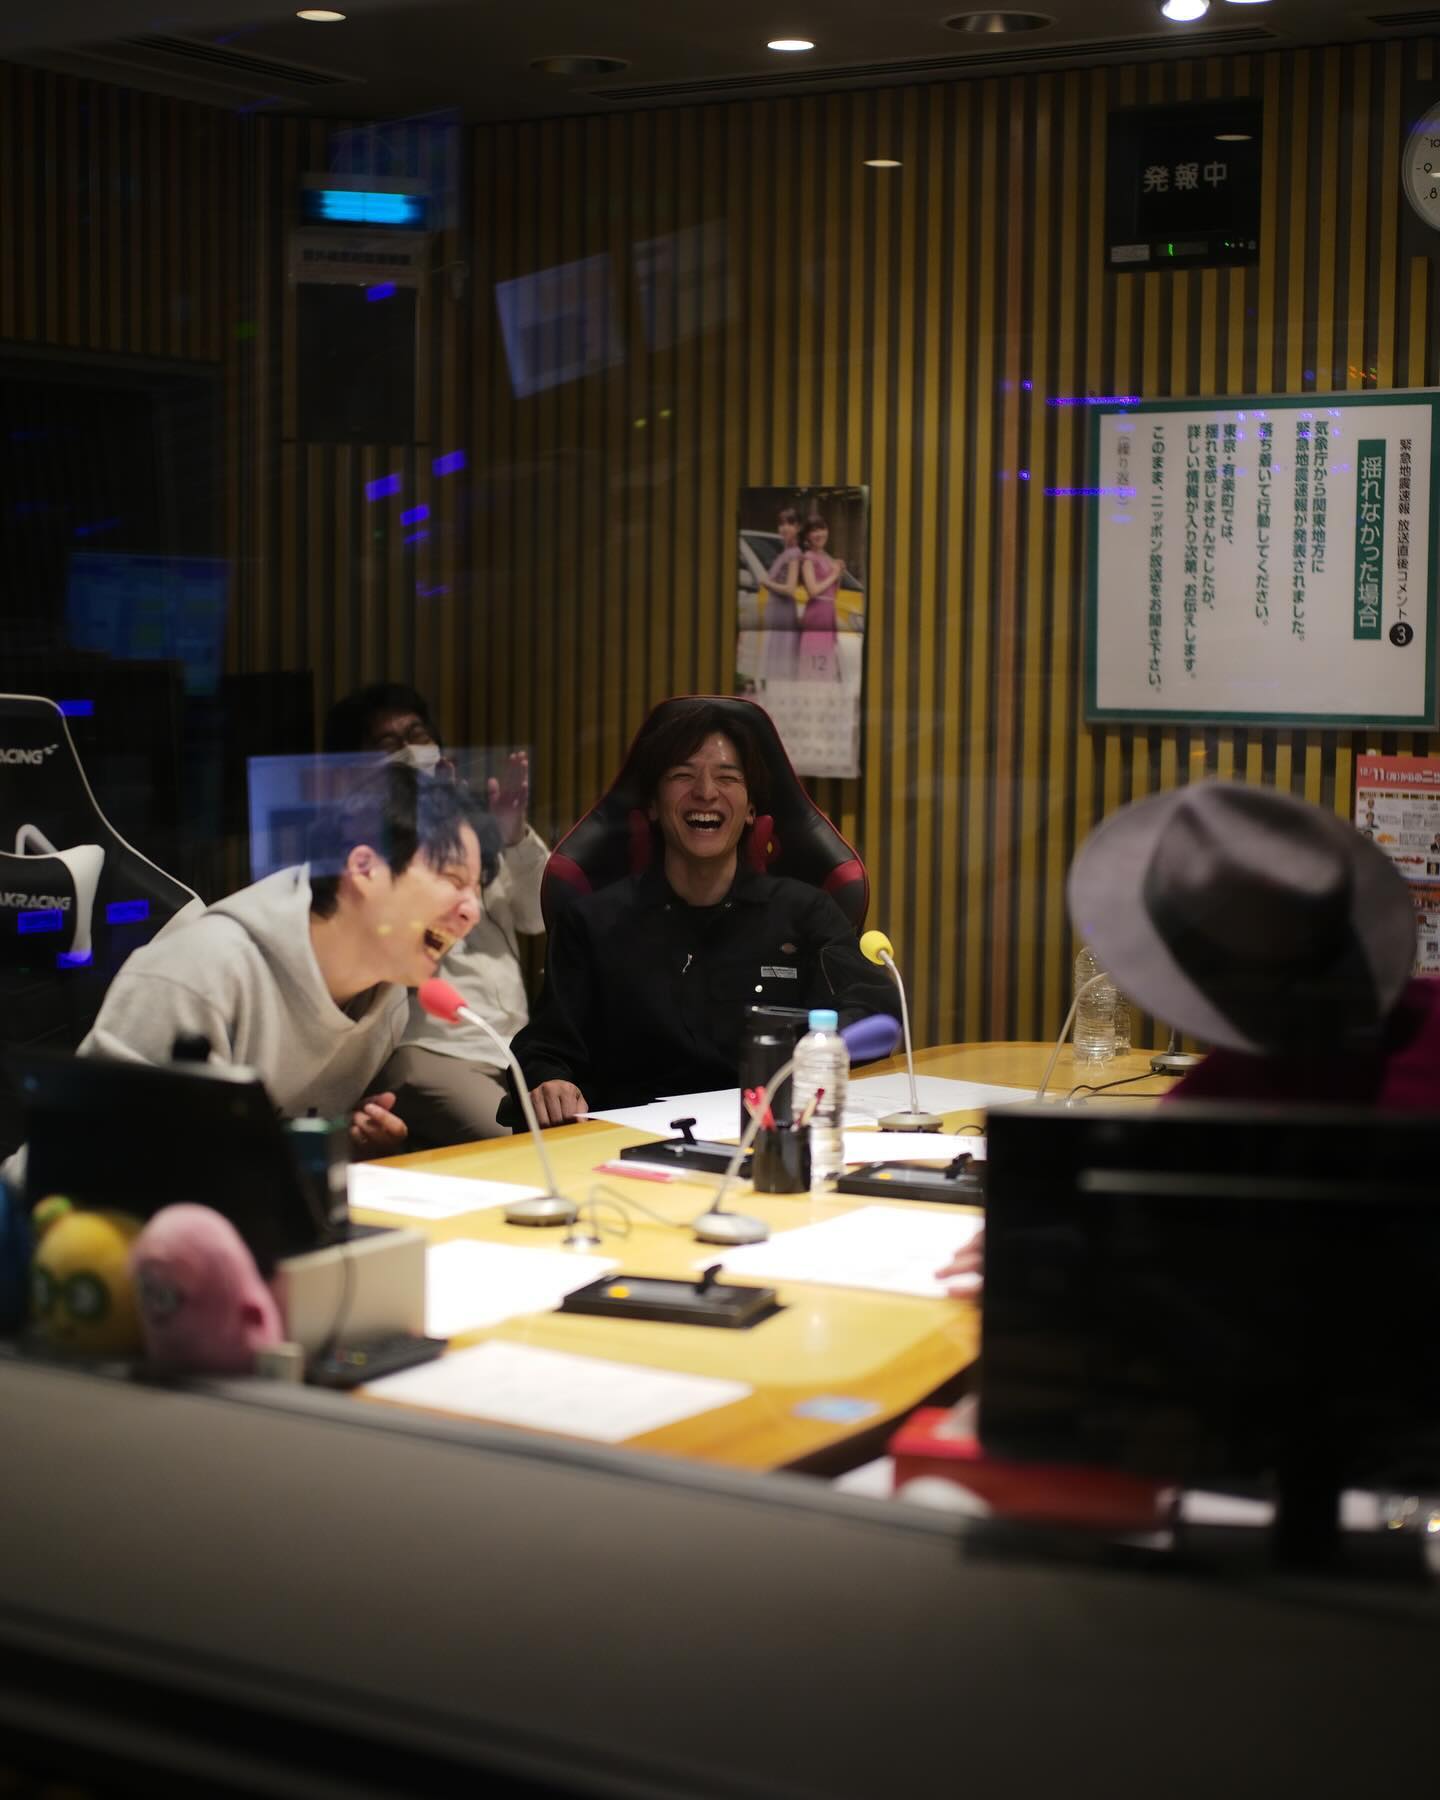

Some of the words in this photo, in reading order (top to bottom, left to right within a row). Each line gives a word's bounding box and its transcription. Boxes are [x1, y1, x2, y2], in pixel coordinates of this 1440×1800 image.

[1144, 161, 1227, 193] 発報中
[1423, 162, 1433, 174] 9
[1429, 187, 1438, 199] 8
[1311, 421, 1329, 573] 気象庁から関東地方に
[1398, 439, 1412, 515] 緊急地震速報
[1358, 456, 1383, 628] 揺れなかった場合
[1396, 519, 1410, 620] 放送直後コメント
[811, 655, 828, 671] 12
